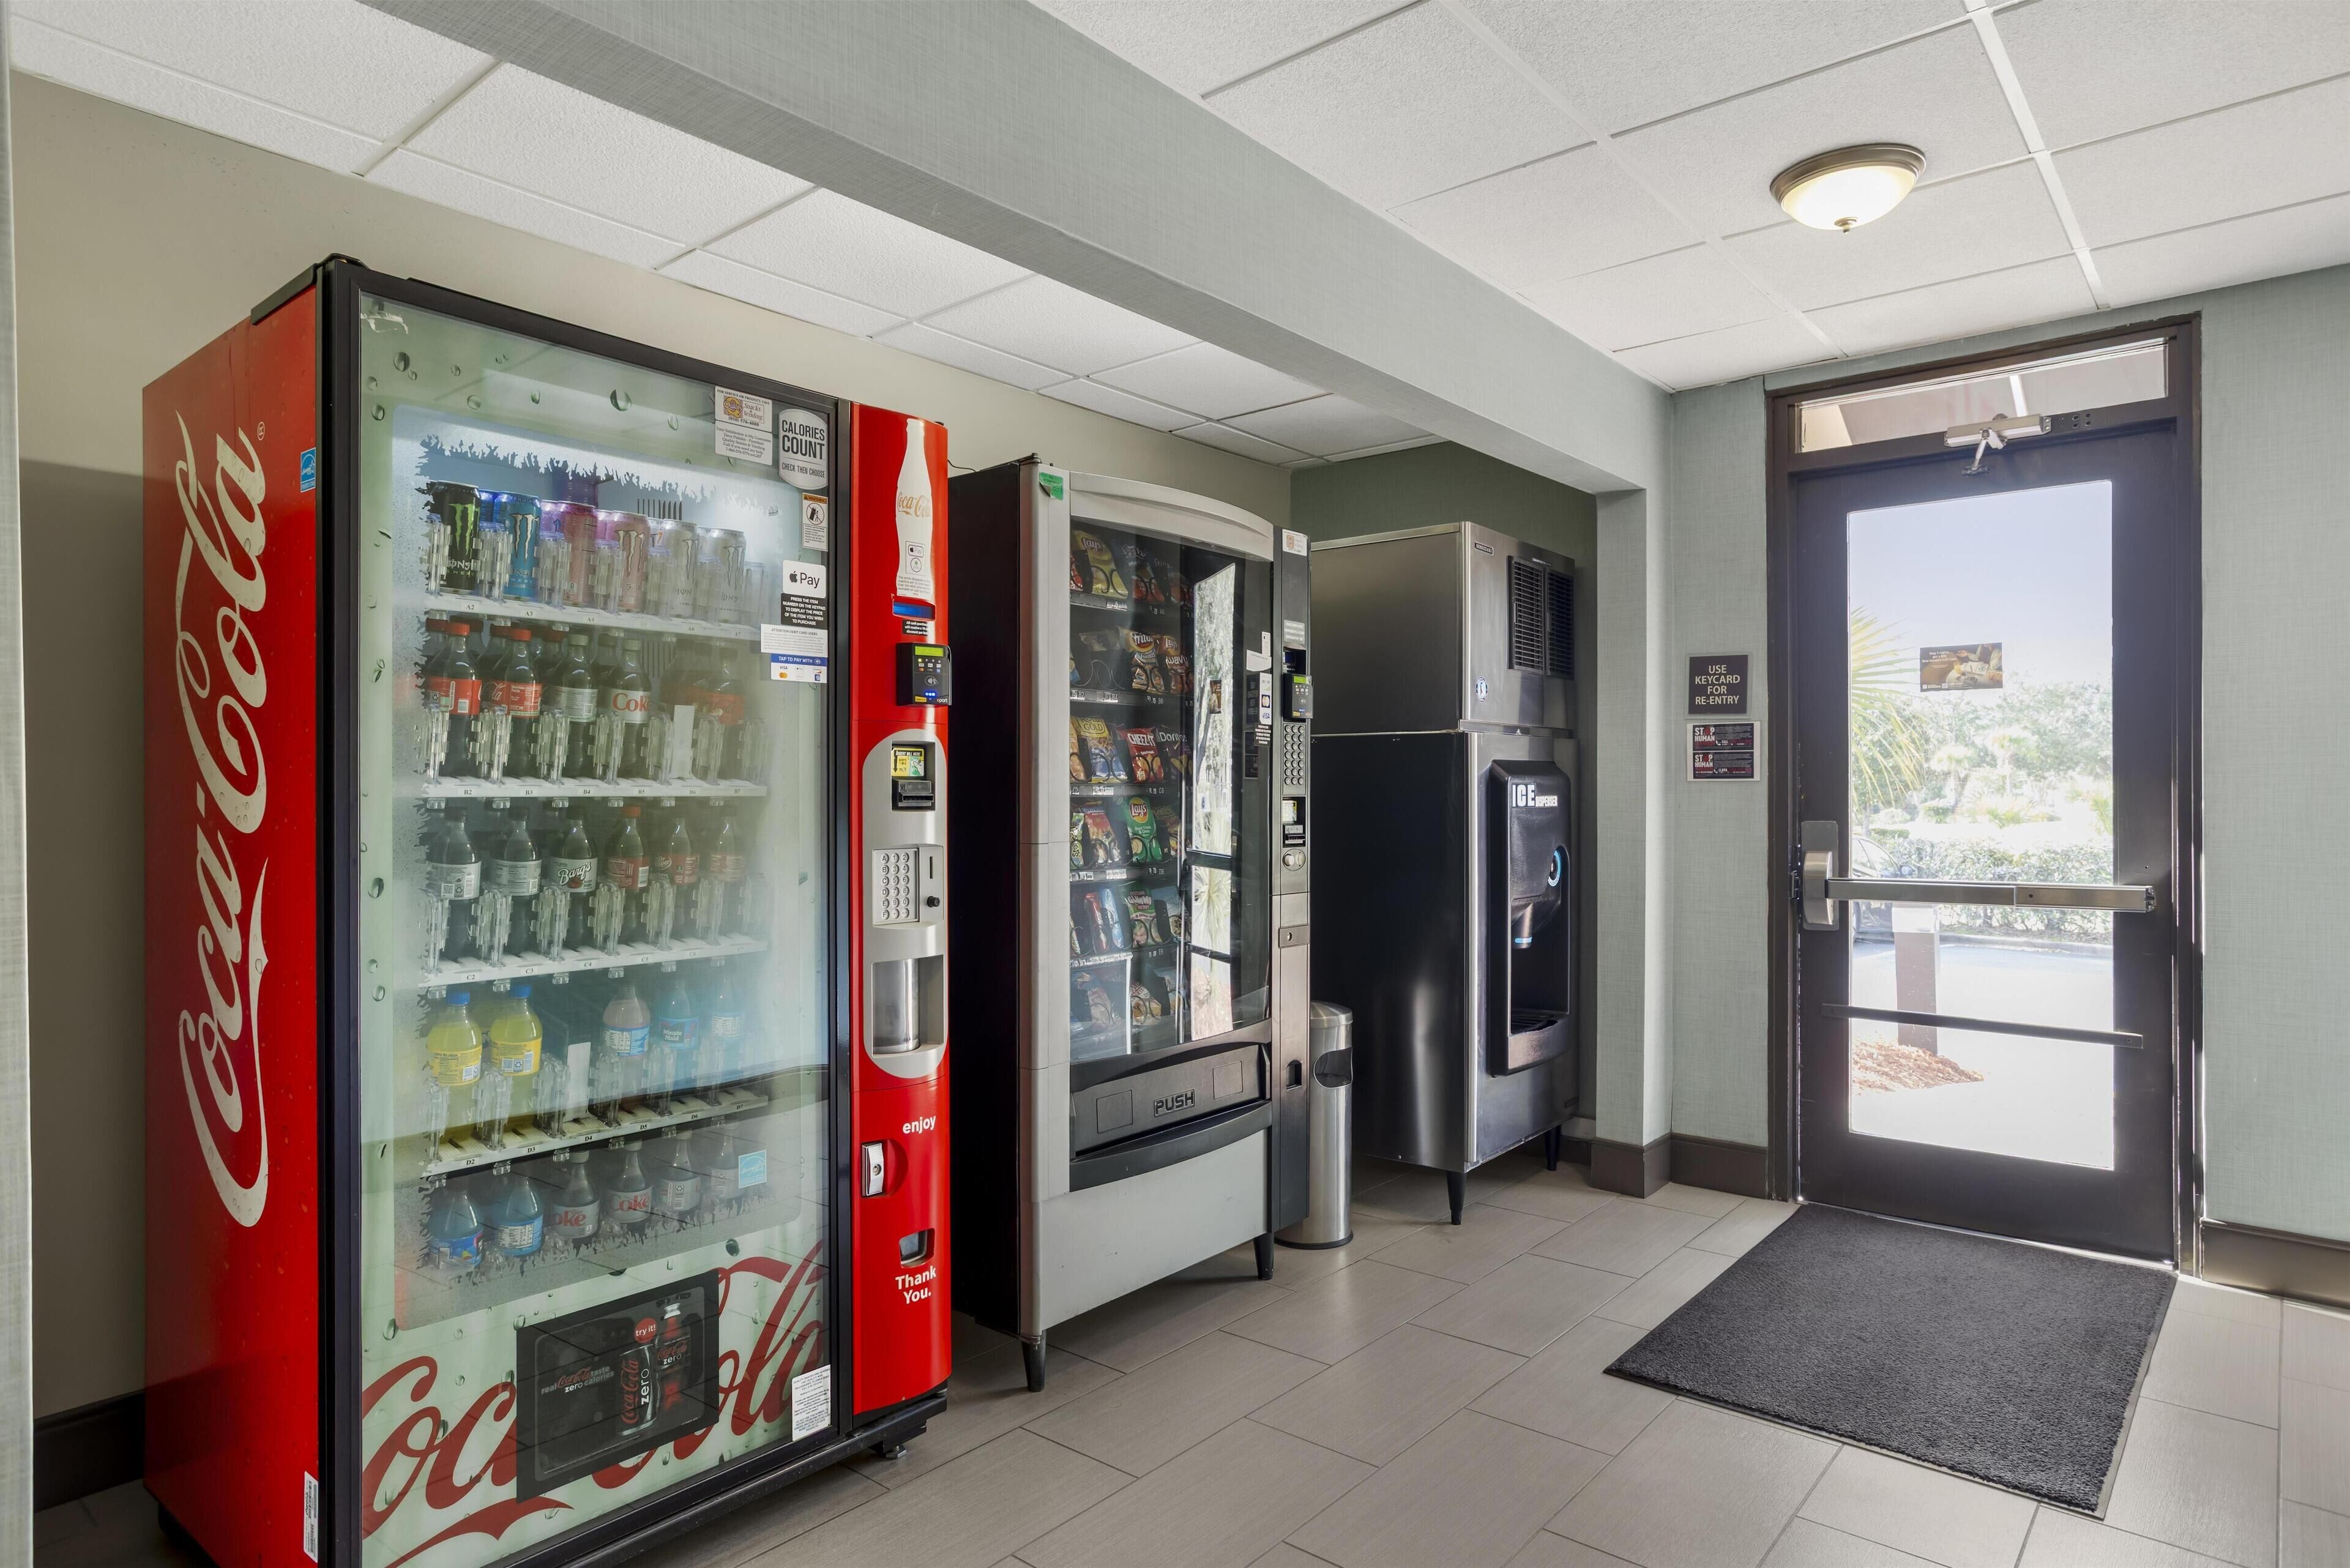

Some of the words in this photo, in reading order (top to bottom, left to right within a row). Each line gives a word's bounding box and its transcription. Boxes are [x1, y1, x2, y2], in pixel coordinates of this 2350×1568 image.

[744, 403, 761, 412] Snacks
[744, 410, 763, 421] Vending
[781, 420, 825, 441] CALORIES
[782, 435, 825, 460] COUNT
[781, 462, 796, 472] CHECK
[797, 465, 808, 475] THEN
[809, 468, 825, 478] CHOOSE
[800, 572, 820, 589] Pay
[1709, 665, 1727, 674] USE
[1695, 675, 1740, 685] KEYCARD
[1707, 685, 1727, 695] FOR
[612, 692, 649, 712] Cok
[1695, 695, 1740, 705] RE-ENTRY
[1512, 784, 1535, 807] ICE
[1132, 803, 1147, 817] Lay's
[176, 411, 267, 1227] Coca-Cola
[1127, 895, 1152, 905] GUMMI
[1154, 1090, 1194, 1117] PUSH
[902, 1115, 936, 1135] enjoy
[551, 1210, 587, 1228] oke
[895, 1264, 936, 1290] Thank
[903, 1287, 931, 1304] You.
[635, 1327, 648, 1337] try
[647, 1323, 657, 1333] it!
[663, 1353, 682, 1365] zero
[540, 1382, 558, 1395] real
[590, 1365, 610, 1377] taste
[564, 1382, 583, 1394] zero
[584, 1370, 614, 1387] calories
[641, 1368, 650, 1406] zero
[621, 1358, 640, 1425] Coca-Cola
